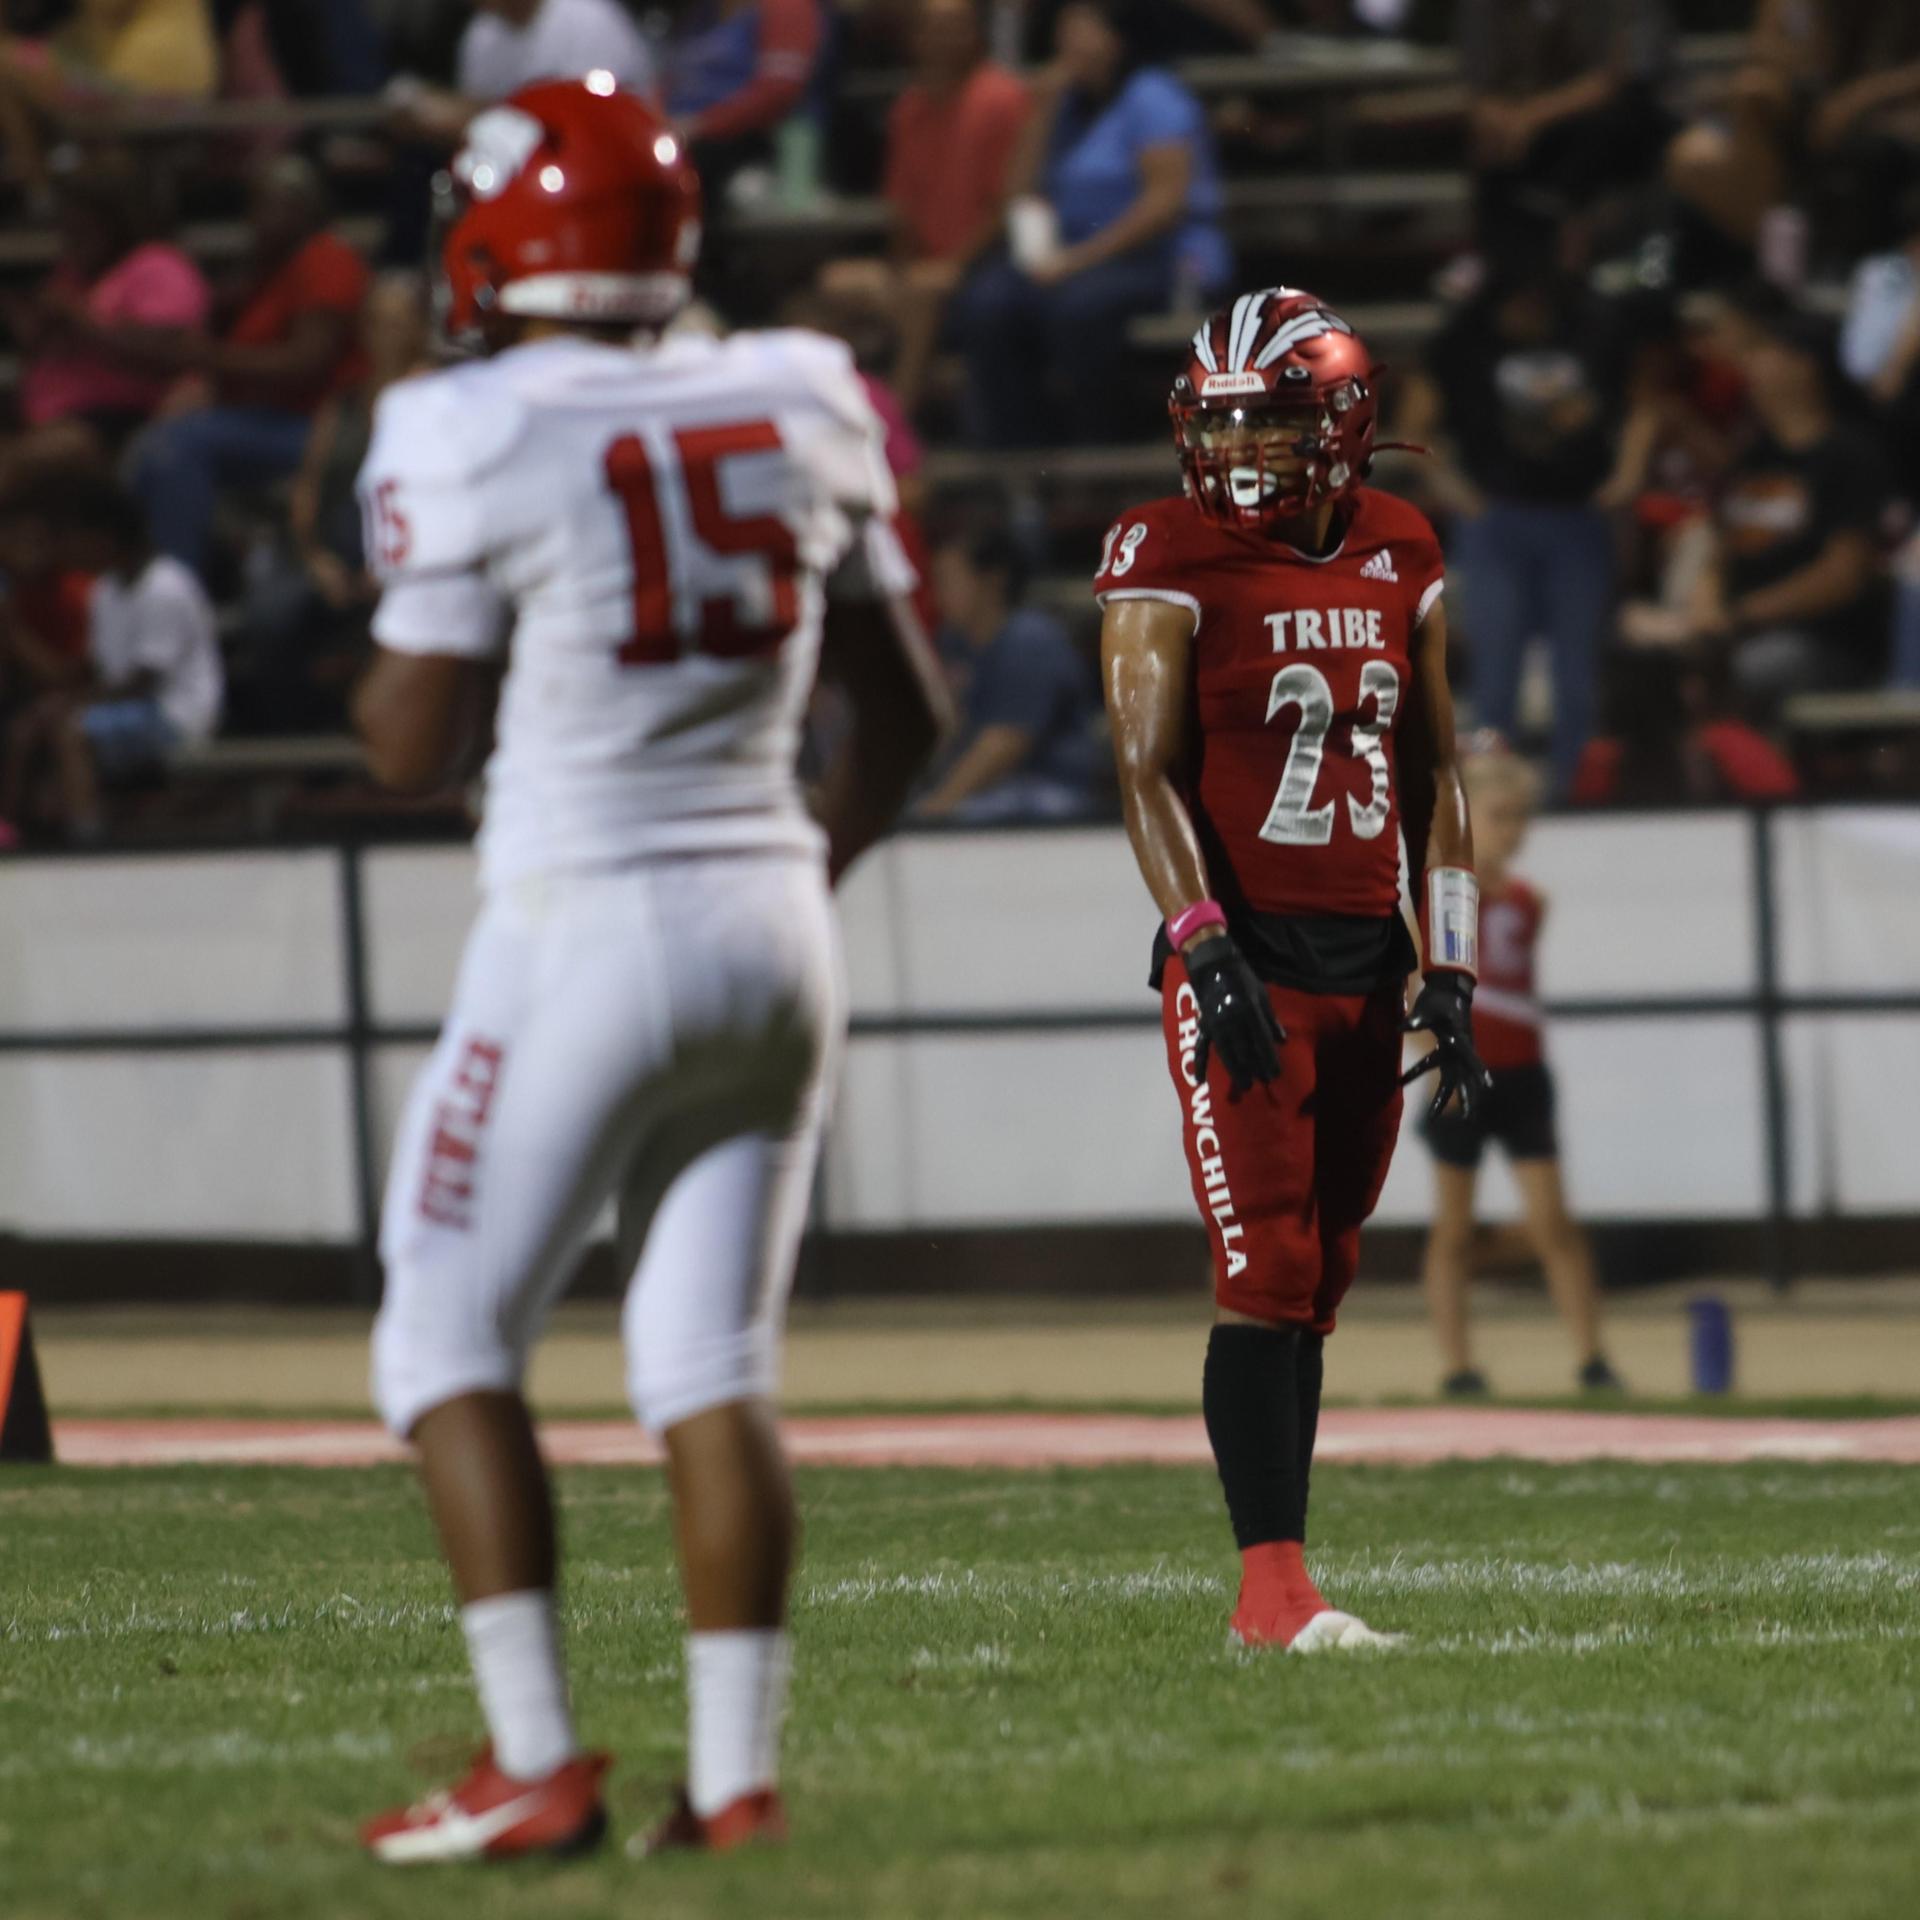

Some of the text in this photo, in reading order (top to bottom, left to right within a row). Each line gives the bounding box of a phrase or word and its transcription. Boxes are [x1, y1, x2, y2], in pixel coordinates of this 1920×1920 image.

[604, 418, 800, 667] 15
[1264, 608, 1386, 653] TRIBE
[1258, 659, 1399, 845] 23
